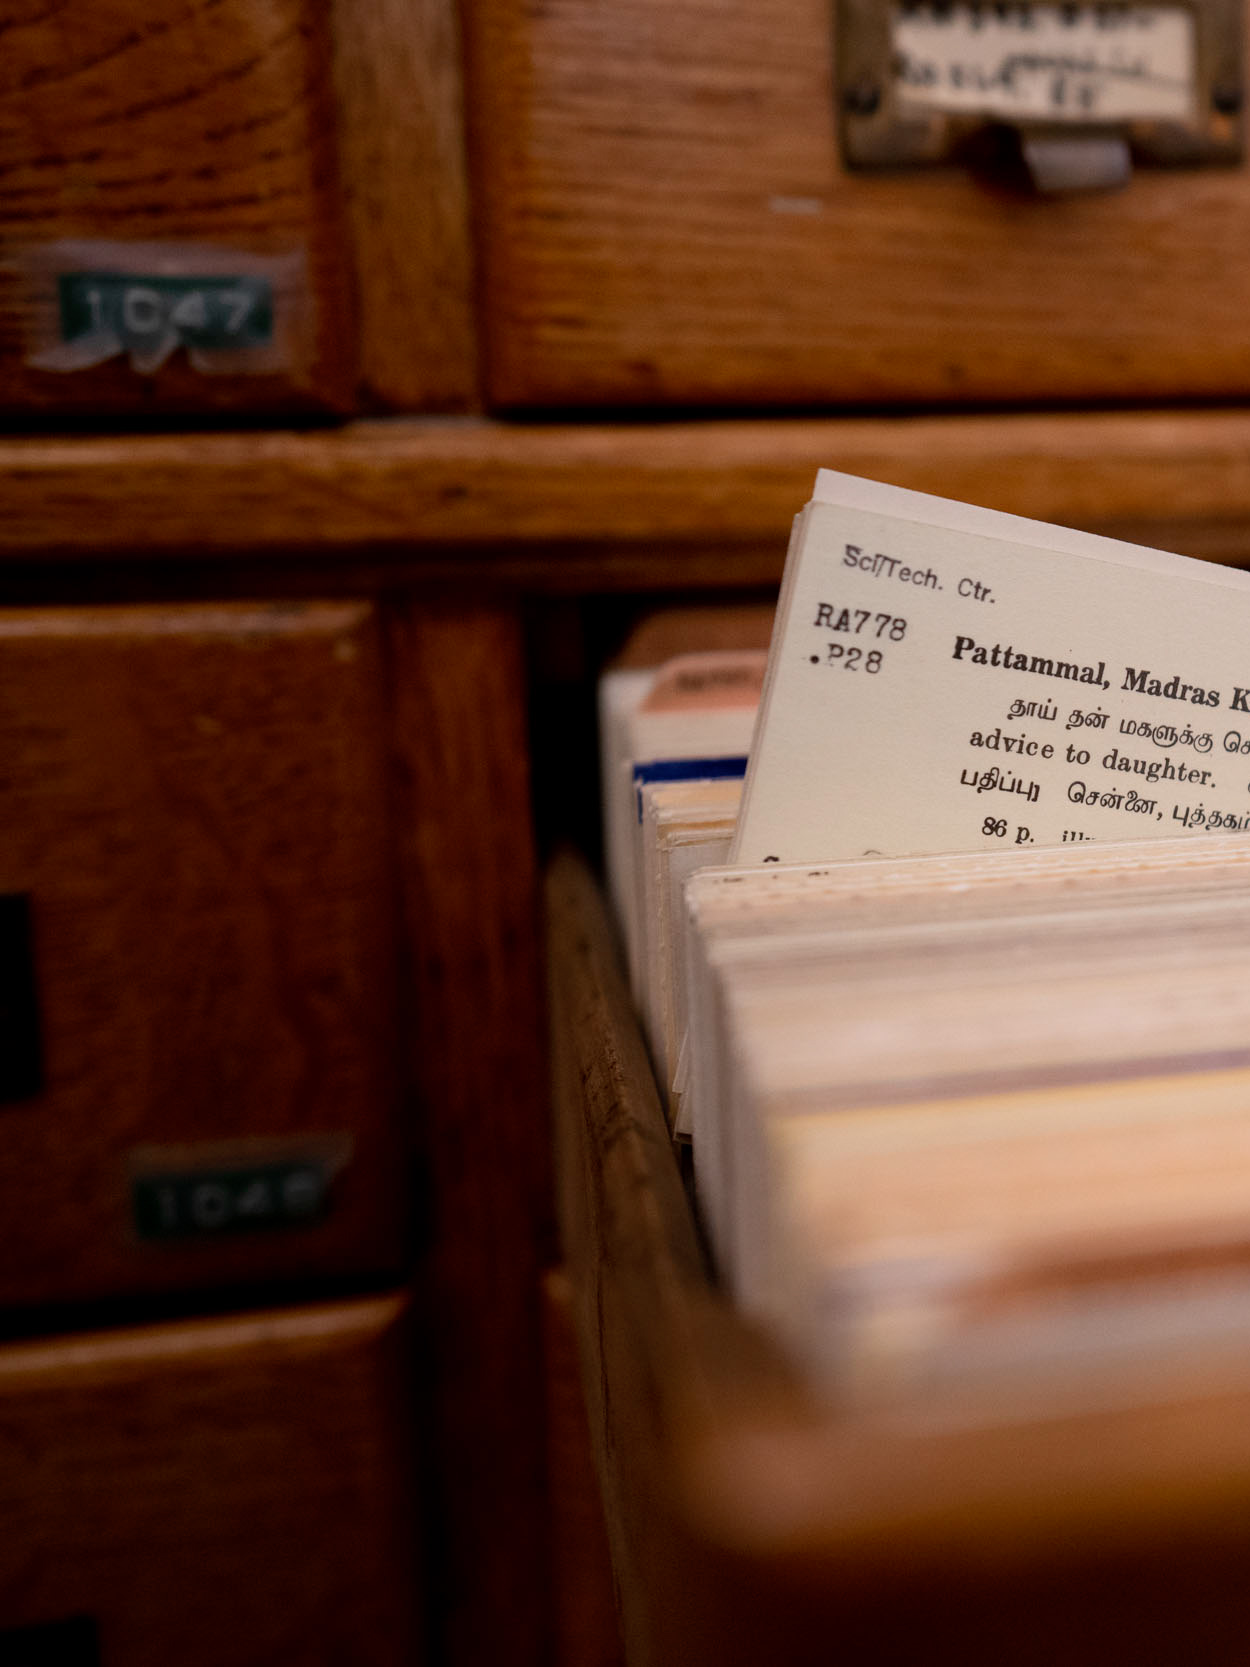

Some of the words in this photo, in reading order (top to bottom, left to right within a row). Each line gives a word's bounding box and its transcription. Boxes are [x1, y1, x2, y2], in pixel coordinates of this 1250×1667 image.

[86, 286, 256, 334] 1047
[843, 545, 944, 591] Sci/Tech.
[957, 577, 997, 604] Ctr.
[813, 602, 907, 642] RA778
[809, 643, 884, 675] .P28
[952, 635, 1111, 690] Pattammal,
[1120, 667, 1220, 708] Madras
[1008, 698, 1058, 722] தாய்
[1065, 706, 1111, 731] தன்
[1119, 719, 1214, 753] மகளுக்கு
[969, 727, 1055, 760] advice
[1066, 743, 1091, 765] to
[1102, 749, 1217, 789] daughter.
[1067, 781, 1163, 820] சென்னை,
[981, 816, 1008, 838] 86
[1015, 826, 1035, 845] p.
